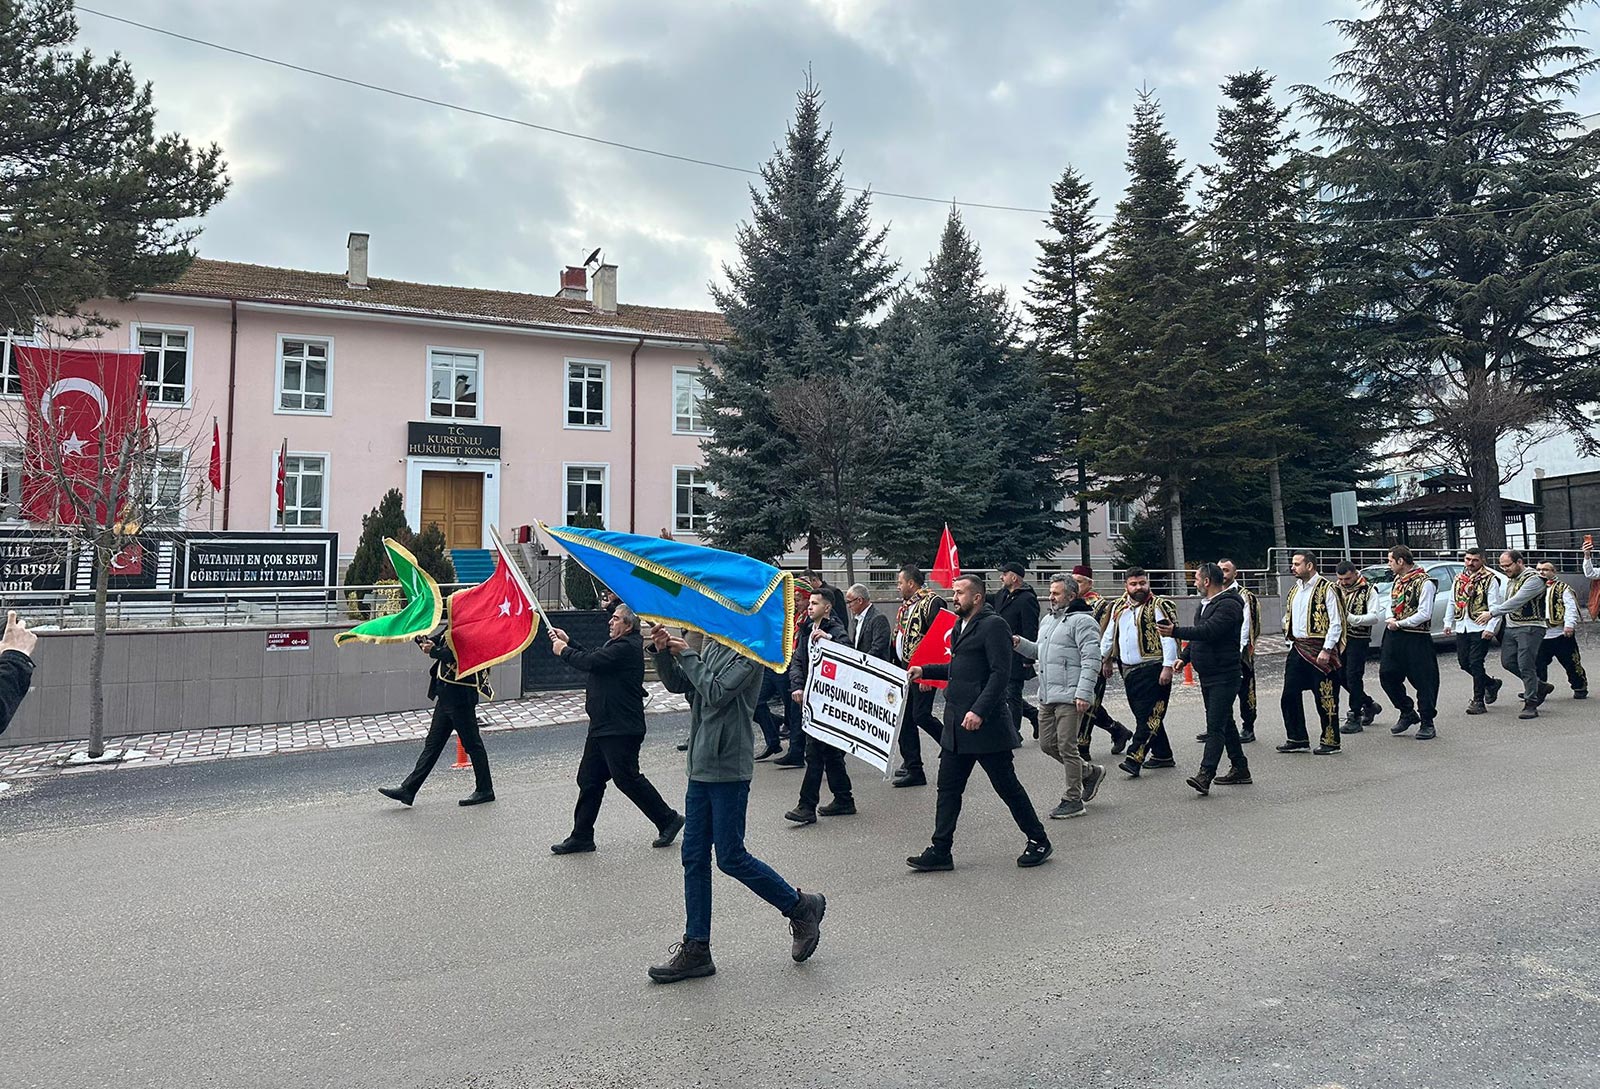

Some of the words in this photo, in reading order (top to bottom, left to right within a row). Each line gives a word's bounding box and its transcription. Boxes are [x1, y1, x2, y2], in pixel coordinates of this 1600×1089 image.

[428, 435, 482, 446] KURŞUNLU
[464, 446, 500, 457] KONAĞI
[198, 554, 245, 566] VATANINI
[247, 554, 261, 566] EN
[264, 554, 284, 568] ÇOK
[286, 554, 318, 566] SEVEN
[3, 563, 60, 578] ŞARTSIZ
[190, 567, 241, 582] GÖREVİNİ
[244, 570, 257, 581] EN
[260, 568, 274, 581] İYİ
[276, 570, 324, 581] YAPANDIR
[812, 679, 857, 708] KURŞUNLU
[853, 681, 869, 694] 2025
[821, 703, 890, 744] FEDERASYONU
